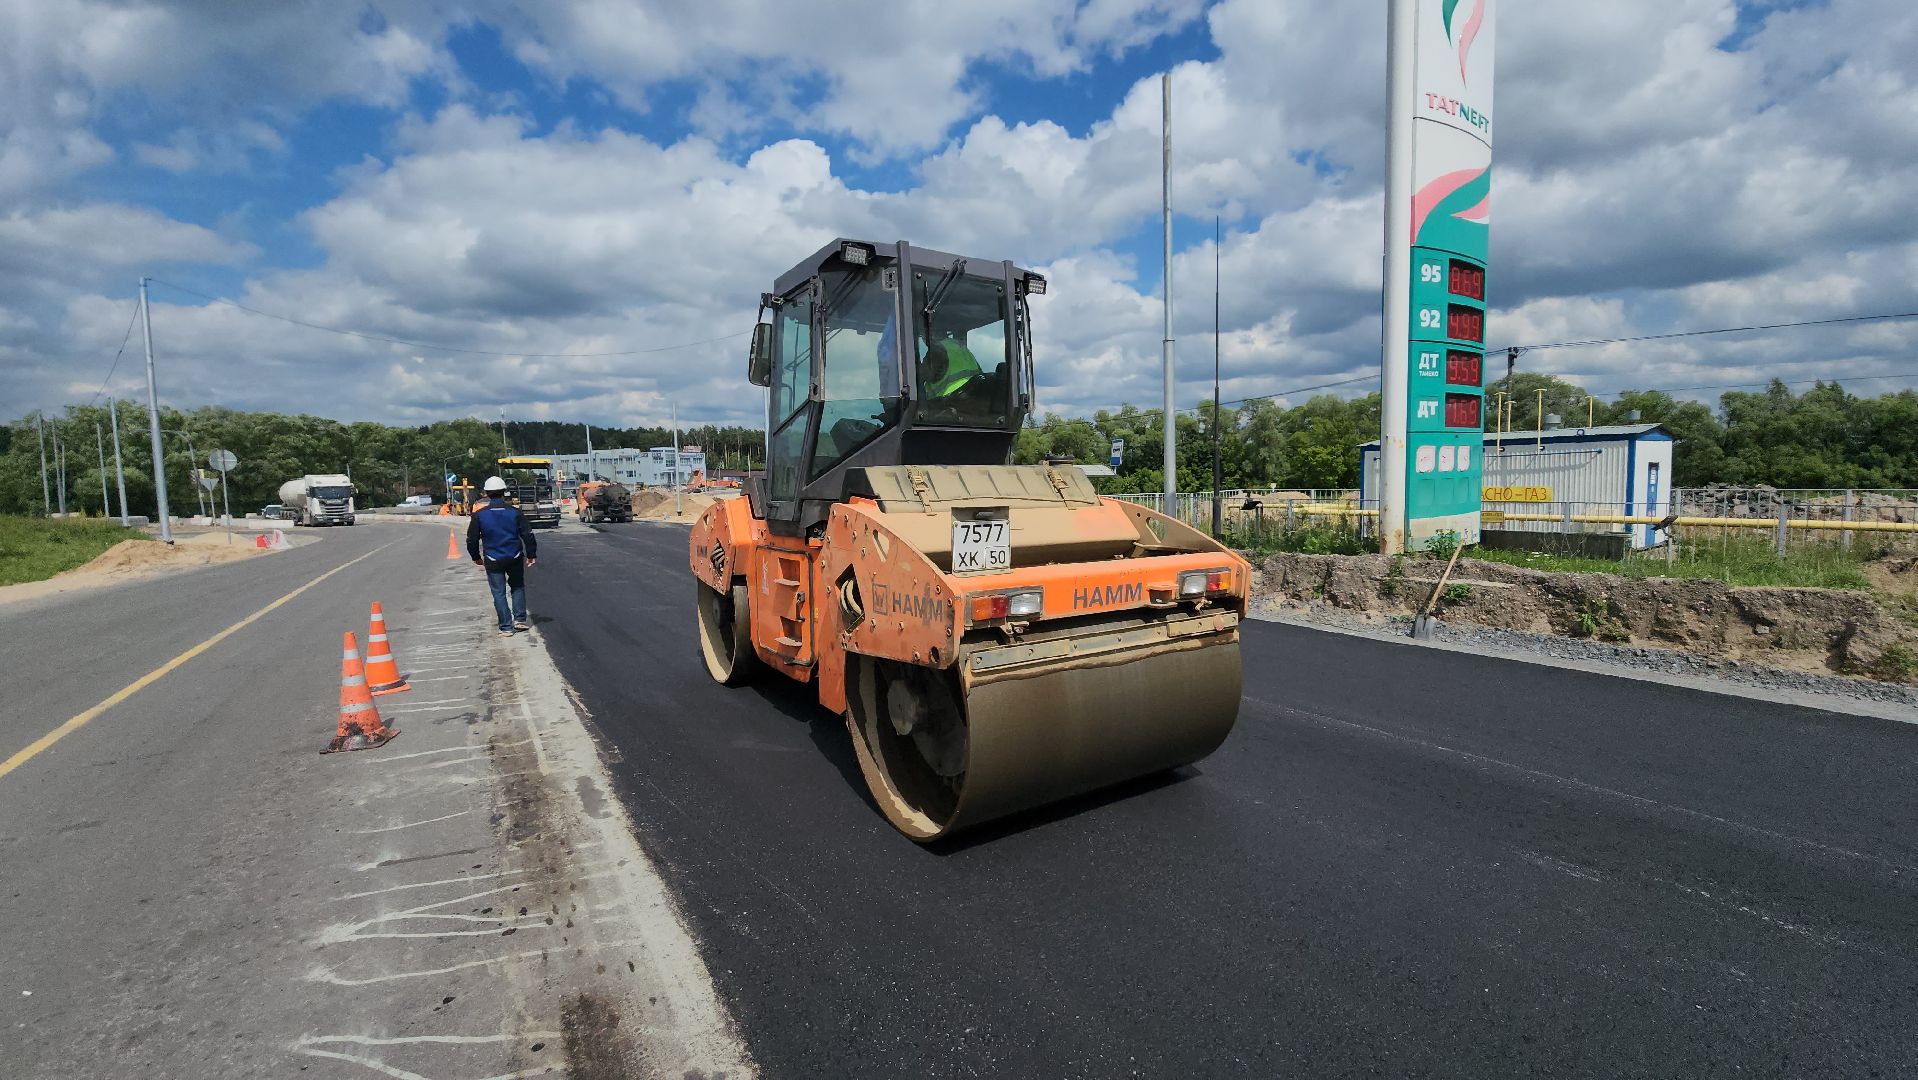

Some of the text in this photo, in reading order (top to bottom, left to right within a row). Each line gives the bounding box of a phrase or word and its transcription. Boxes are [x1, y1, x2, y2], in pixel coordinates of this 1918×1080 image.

[1425, 93, 1489, 133] TATNEFT
[1421, 263, 1441, 282] 95
[1419, 309, 1440, 328] 92
[1419, 352, 1439, 370] ДТ
[1417, 400, 1438, 418] ДТ
[960, 523, 1003, 544] 7577
[958, 550, 1006, 568] ХК 50
[1073, 582, 1143, 609] HAMM
[892, 591, 943, 623] HAMM
